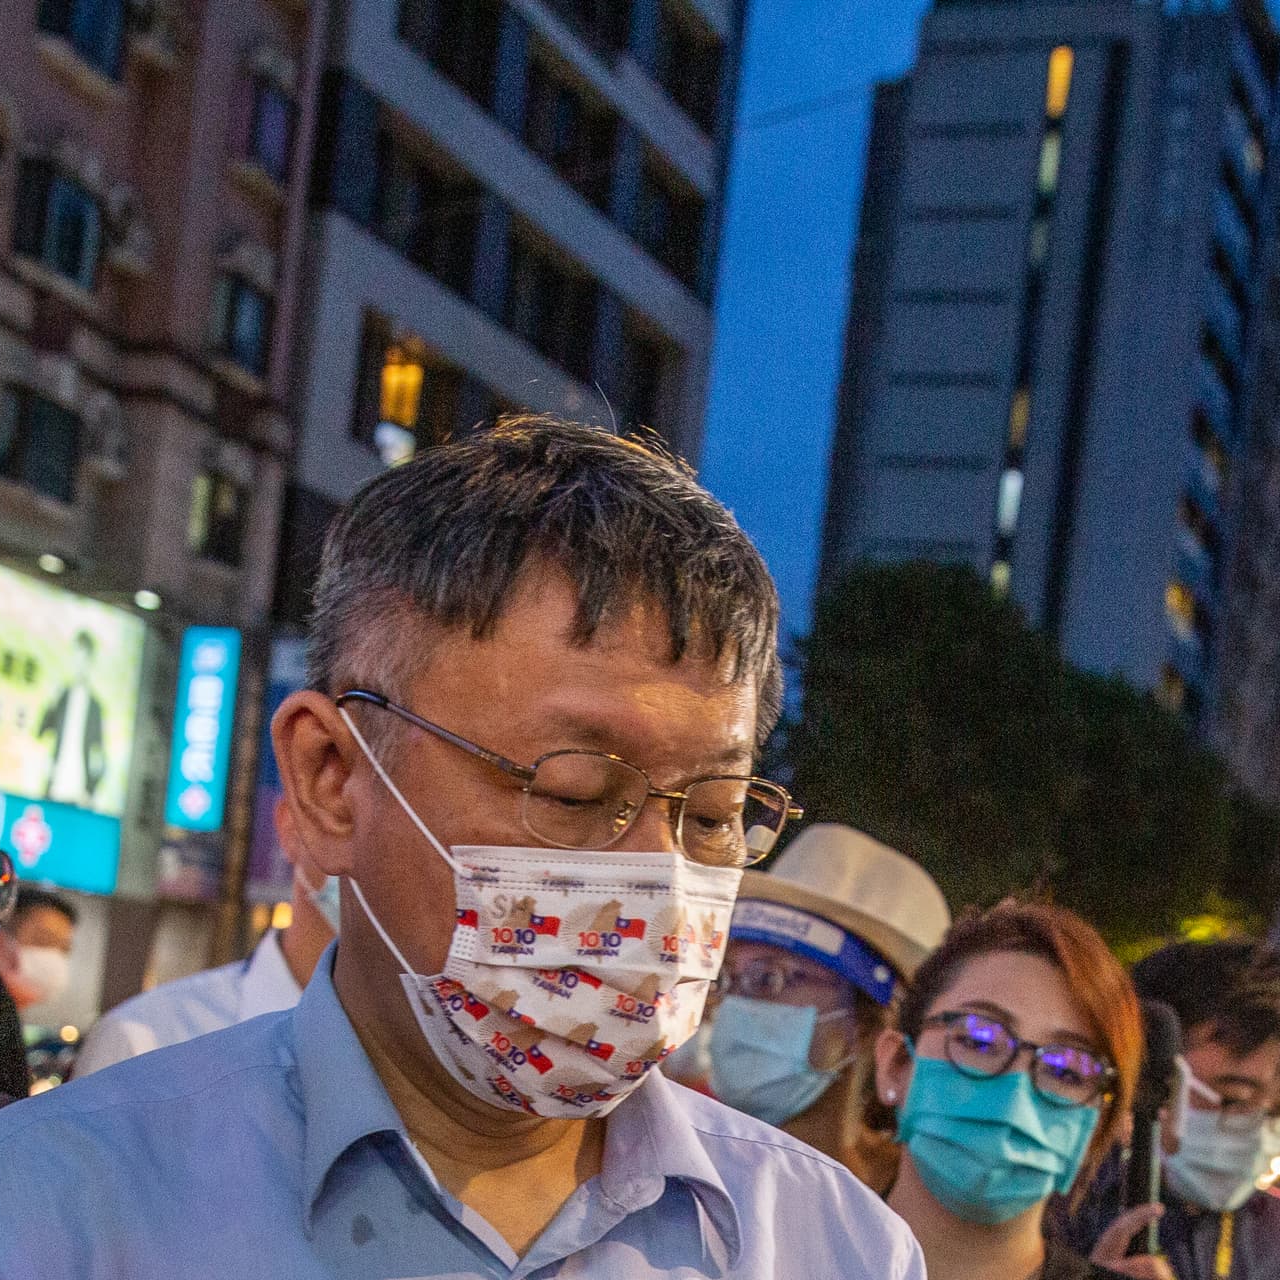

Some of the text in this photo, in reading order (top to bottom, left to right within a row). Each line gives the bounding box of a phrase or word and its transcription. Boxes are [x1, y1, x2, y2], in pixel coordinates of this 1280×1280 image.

[491, 945, 535, 955] TAIWAN
[576, 948, 619, 957] TAIWAN
[532, 976, 573, 999] TAIWAN
